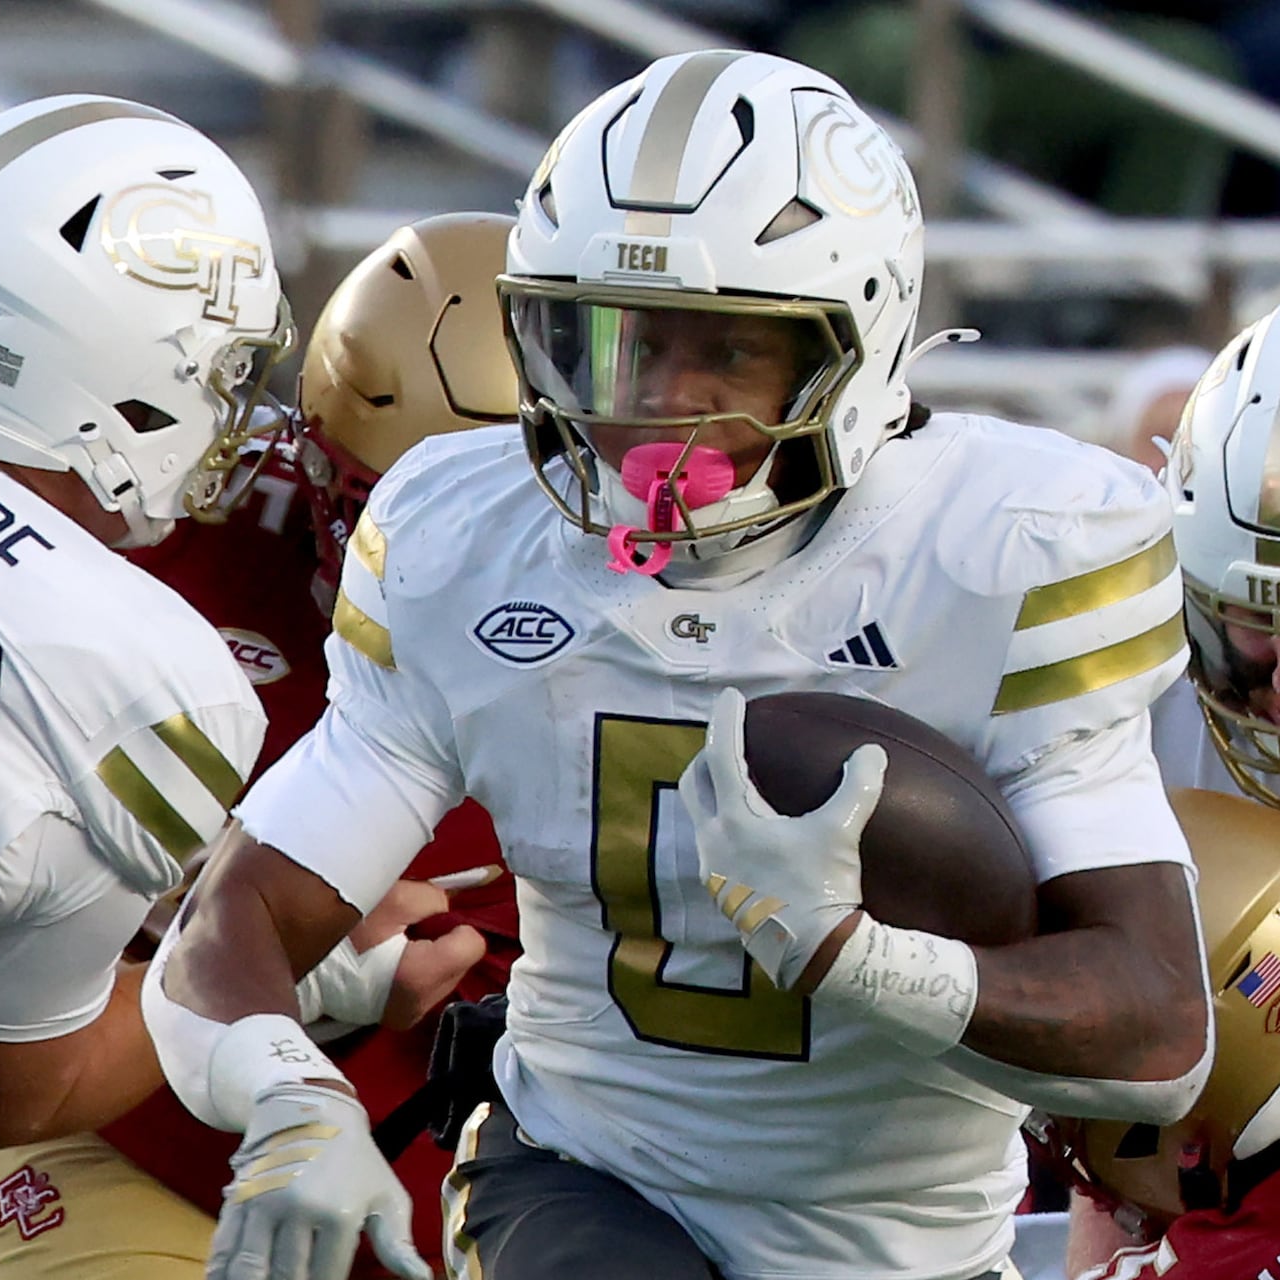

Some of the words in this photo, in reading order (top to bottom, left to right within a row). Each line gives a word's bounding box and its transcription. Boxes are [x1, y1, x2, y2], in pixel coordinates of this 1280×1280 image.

[101, 182, 263, 326] GT
[617, 243, 668, 272] TECH
[489, 616, 561, 638] ACC
[671, 613, 716, 643] GT
